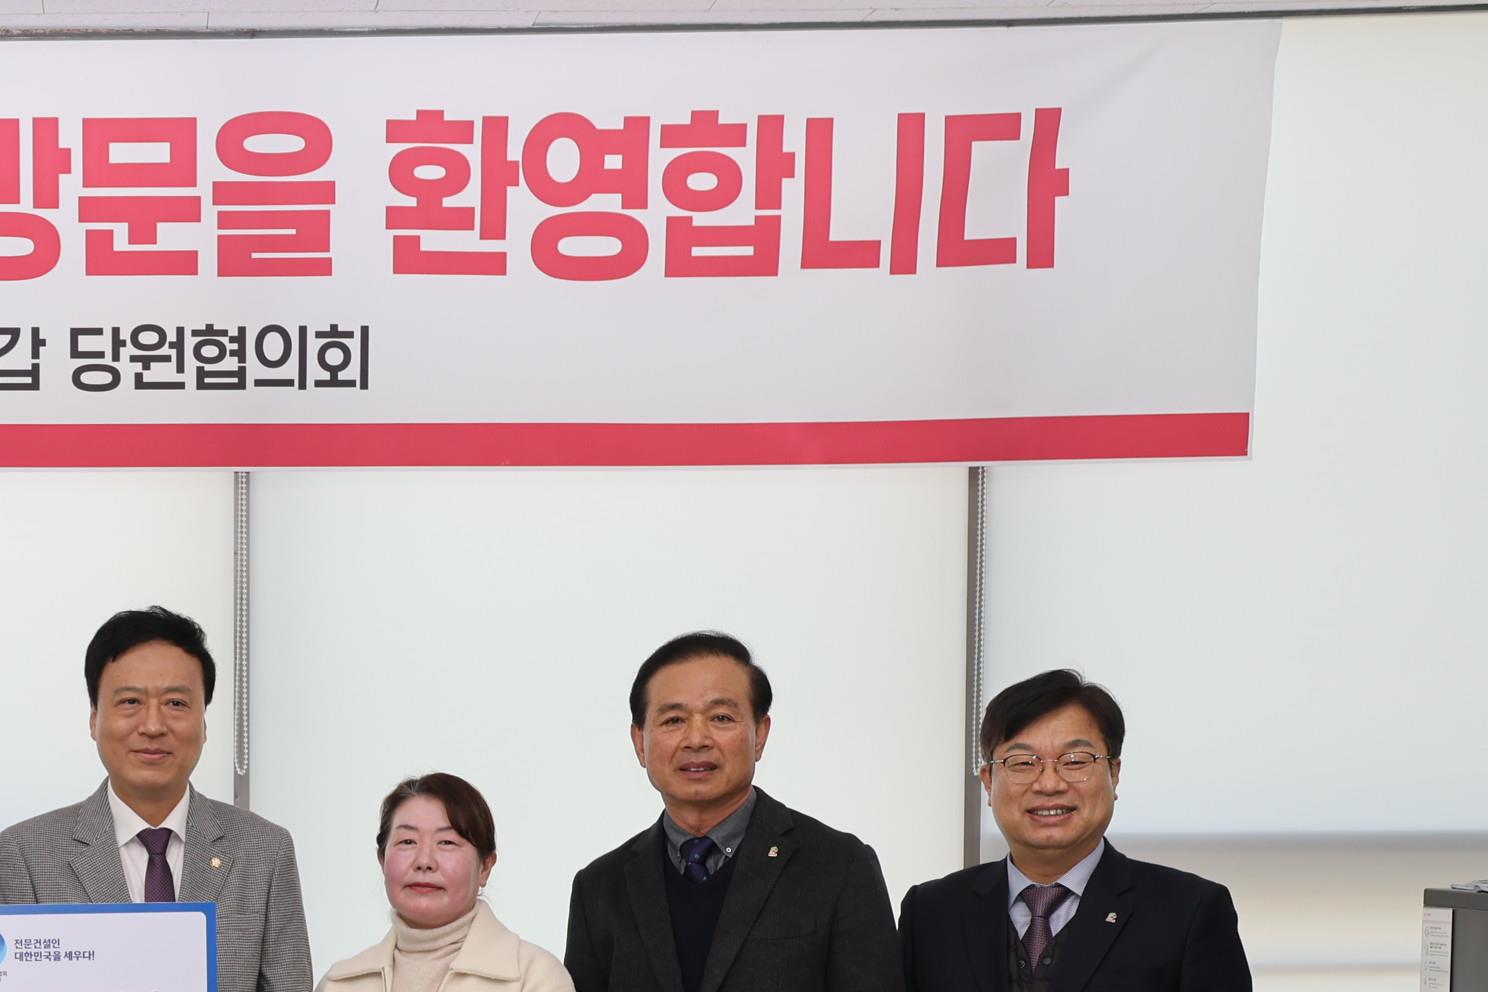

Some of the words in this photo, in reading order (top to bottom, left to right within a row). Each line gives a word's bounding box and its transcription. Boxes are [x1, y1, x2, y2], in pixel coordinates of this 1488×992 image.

[385, 108, 1070, 282] 환영합니다
[69, 323, 370, 393] 당원협의회
[14, 938, 60, 949] 전문건설인
[14, 951, 61, 962] 대한민국을
[64, 950, 95, 961] 세우다!
